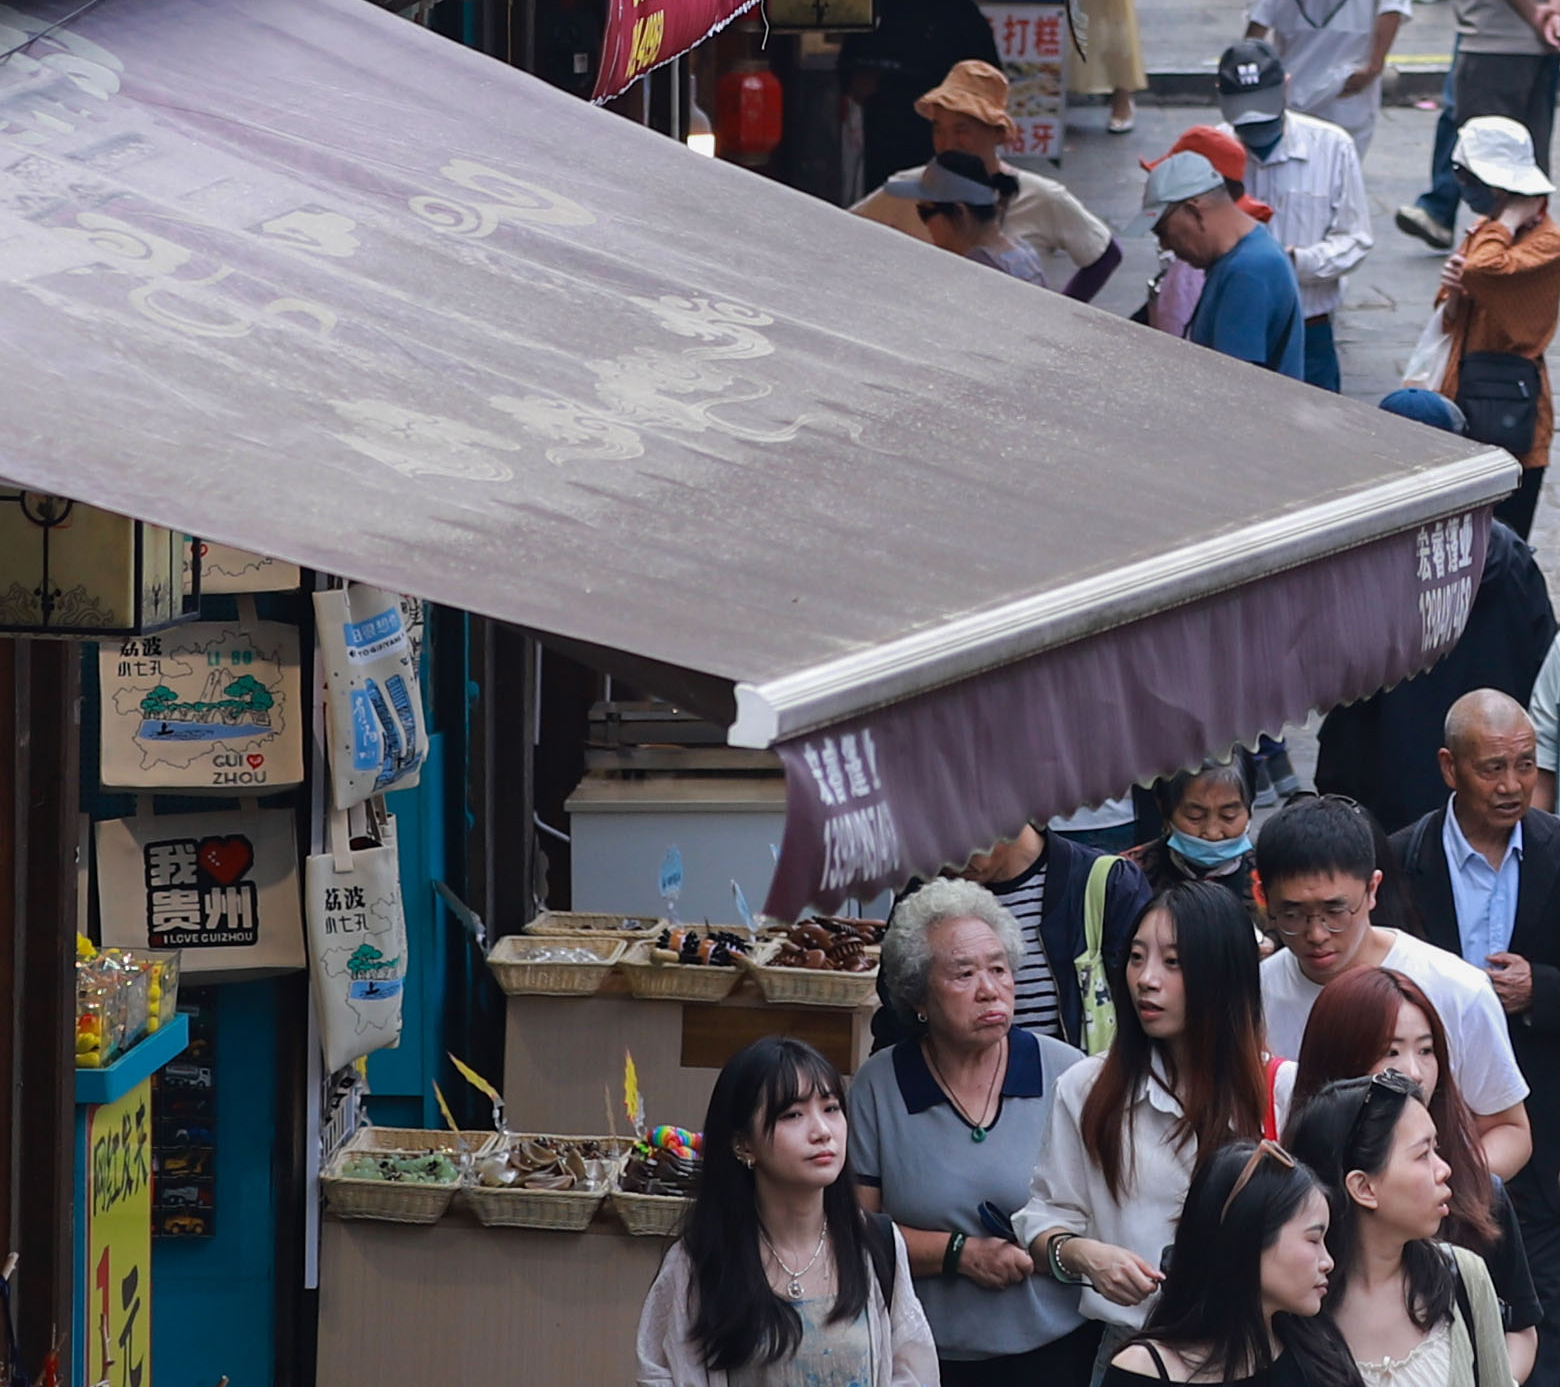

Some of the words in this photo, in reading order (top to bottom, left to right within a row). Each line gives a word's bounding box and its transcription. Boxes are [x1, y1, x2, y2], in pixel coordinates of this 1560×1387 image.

[120, 636, 163, 657] 荔波
[118, 659, 163, 678] 小七孔
[207, 651, 220, 667] LI
[231, 650, 253, 666] BO
[212, 754, 244, 769] GUI
[212, 771, 267, 785] ZHOU
[149, 843, 198, 887] 我
[325, 886, 366, 911] 荔波
[152, 885, 254, 933] 贵州
[325, 913, 370, 935] 小七孔
[170, 933, 199, 944] LOVE
[200, 932, 254, 943] GUIZHOU
